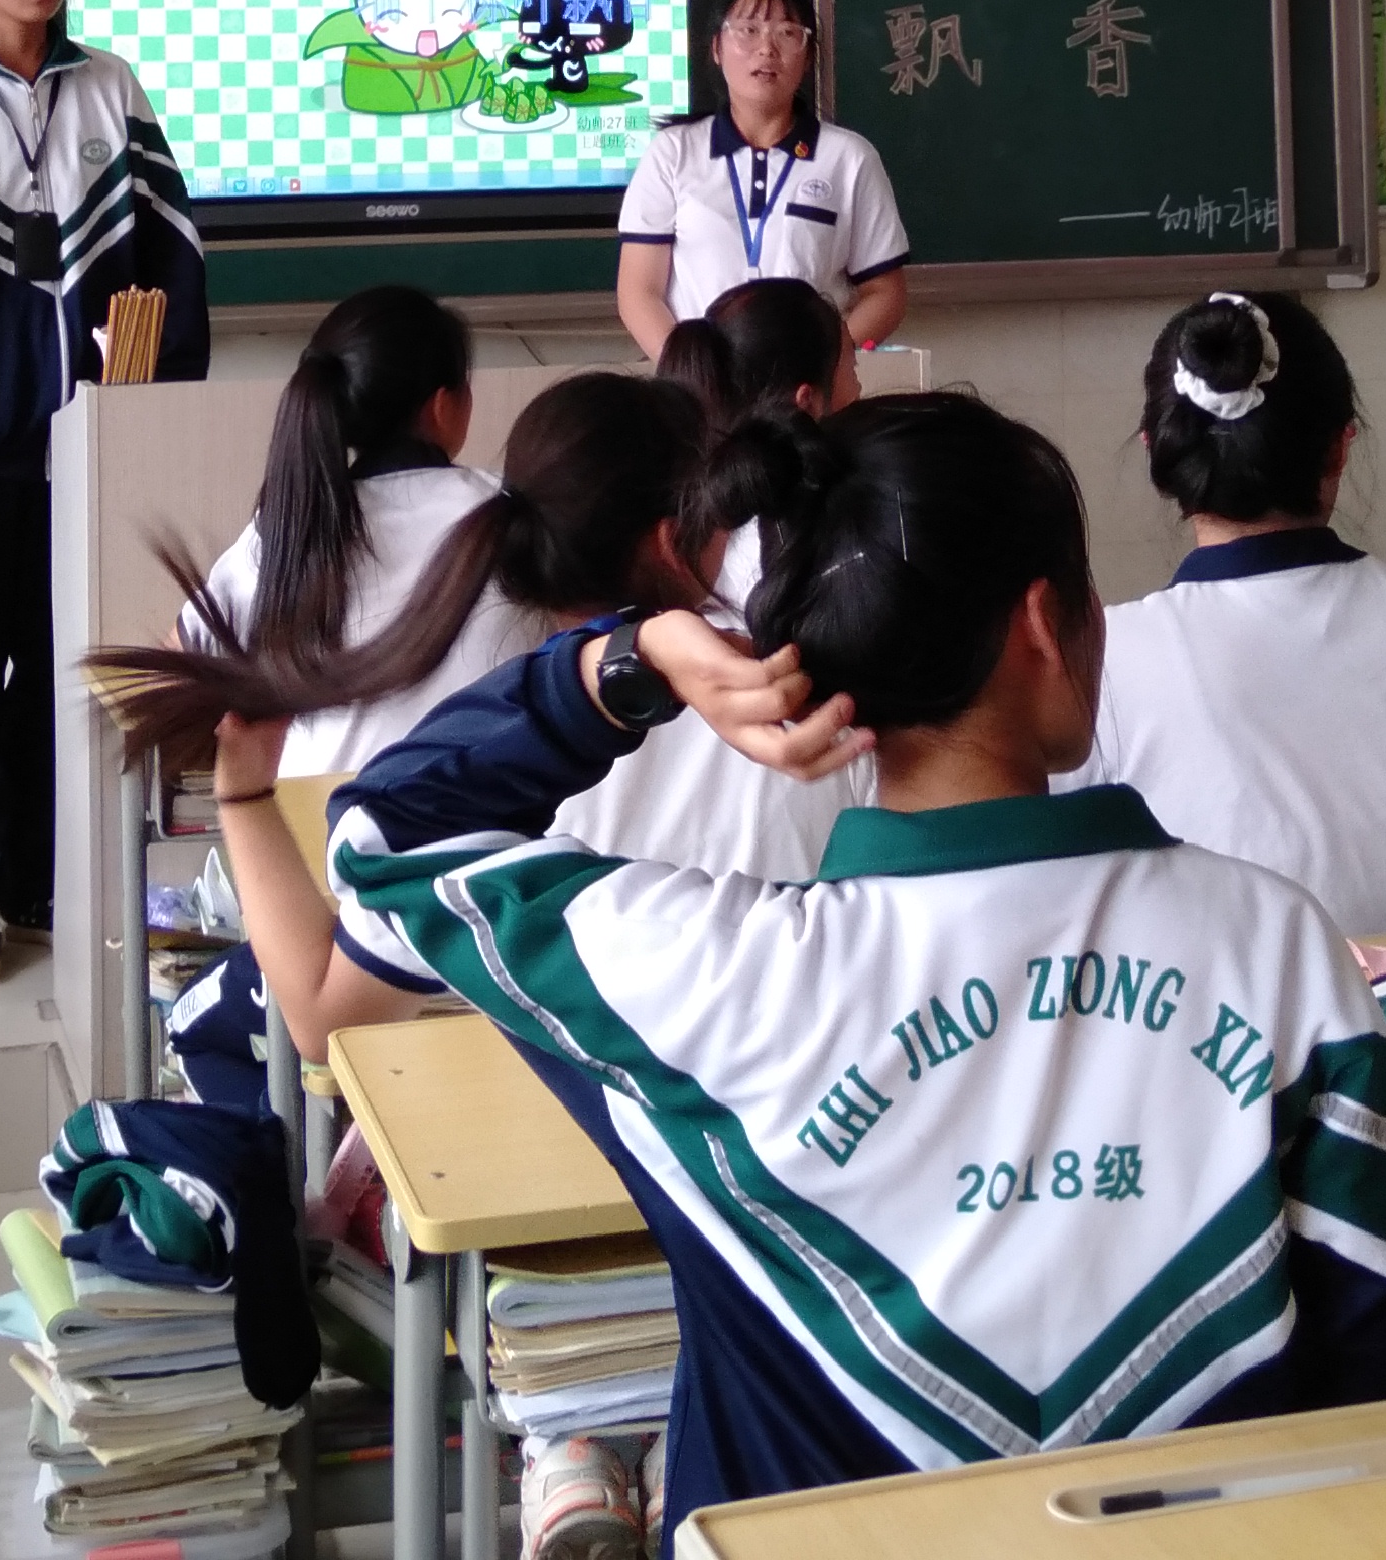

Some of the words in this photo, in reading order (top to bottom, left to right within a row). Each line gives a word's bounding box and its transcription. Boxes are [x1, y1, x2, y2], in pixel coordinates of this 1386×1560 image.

[796, 1063, 894, 1169] ZHI
[890, 976, 1000, 1082] JIAO
[1190, 1001, 1277, 1112] XIN
[954, 1142, 1146, 1214] 2018级
